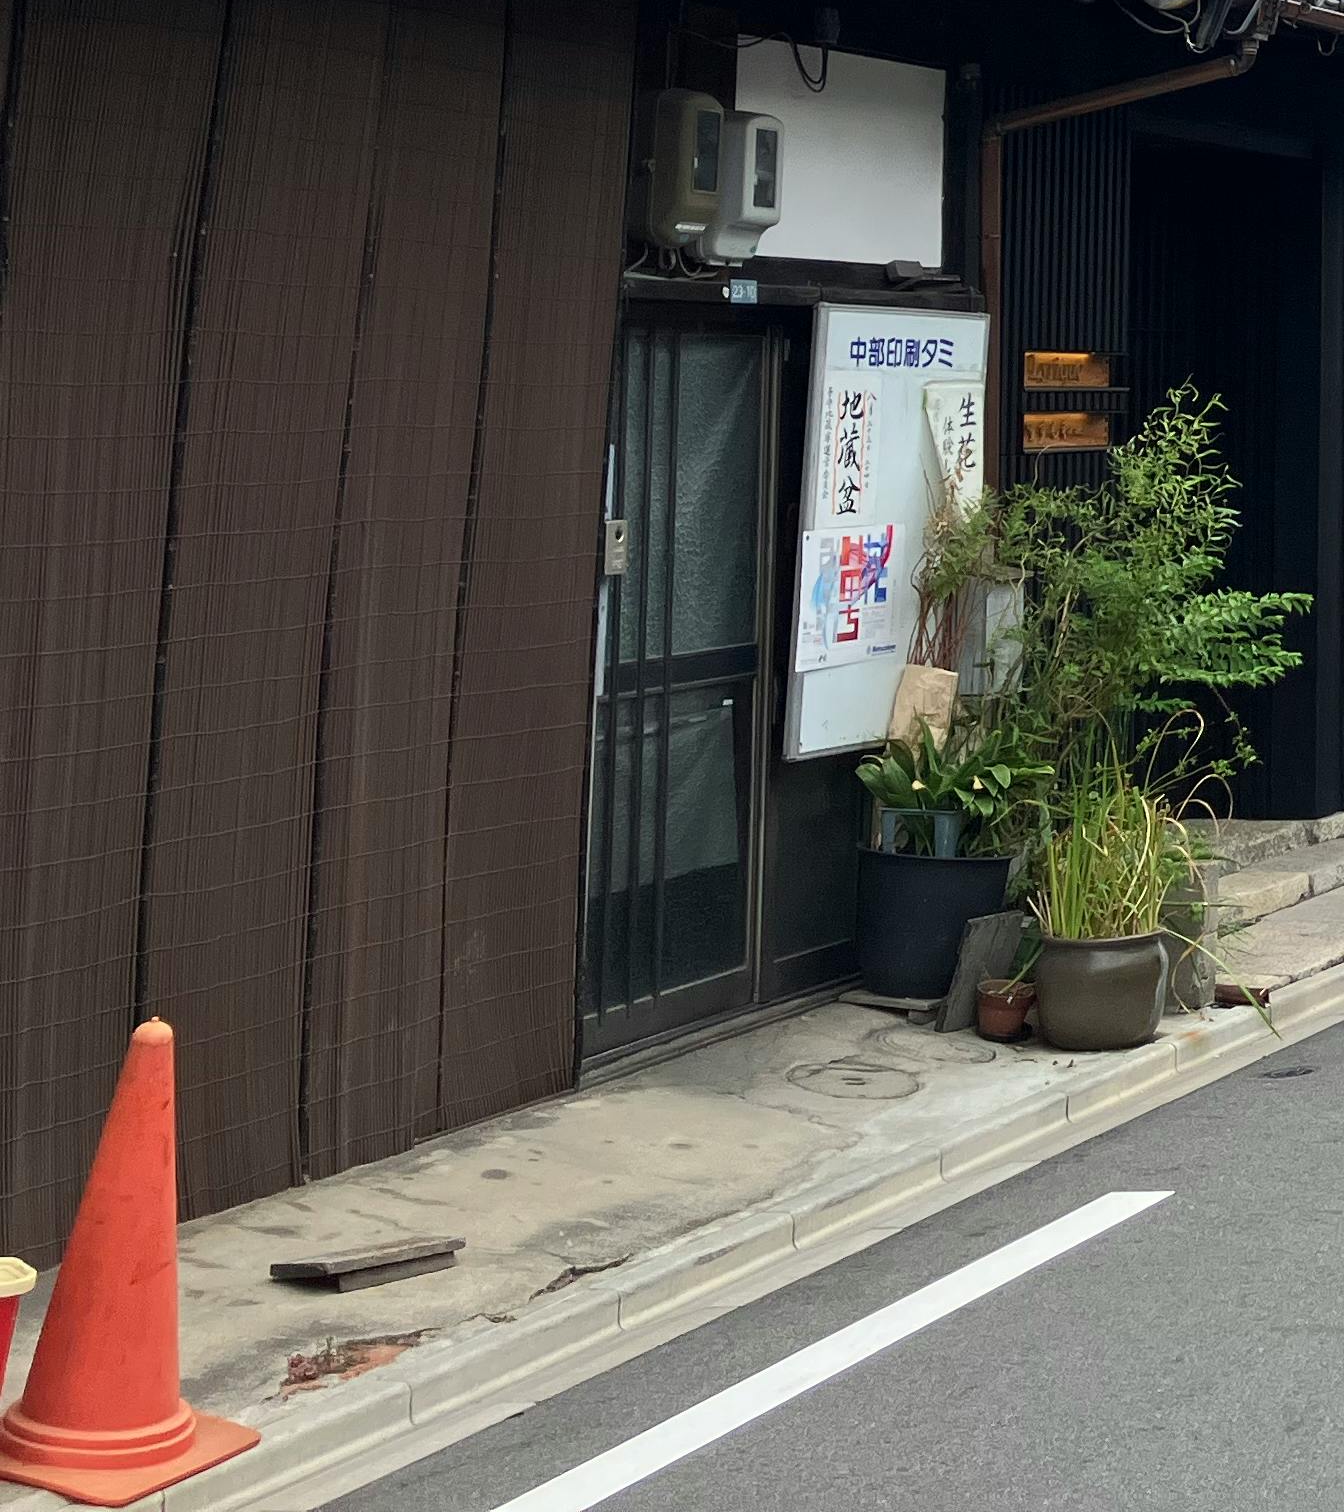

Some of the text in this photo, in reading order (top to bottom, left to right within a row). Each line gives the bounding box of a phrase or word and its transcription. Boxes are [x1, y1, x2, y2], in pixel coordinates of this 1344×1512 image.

[850, 335, 955, 368] 中部印刷タミ
[837, 389, 865, 515] 地蔵盆
